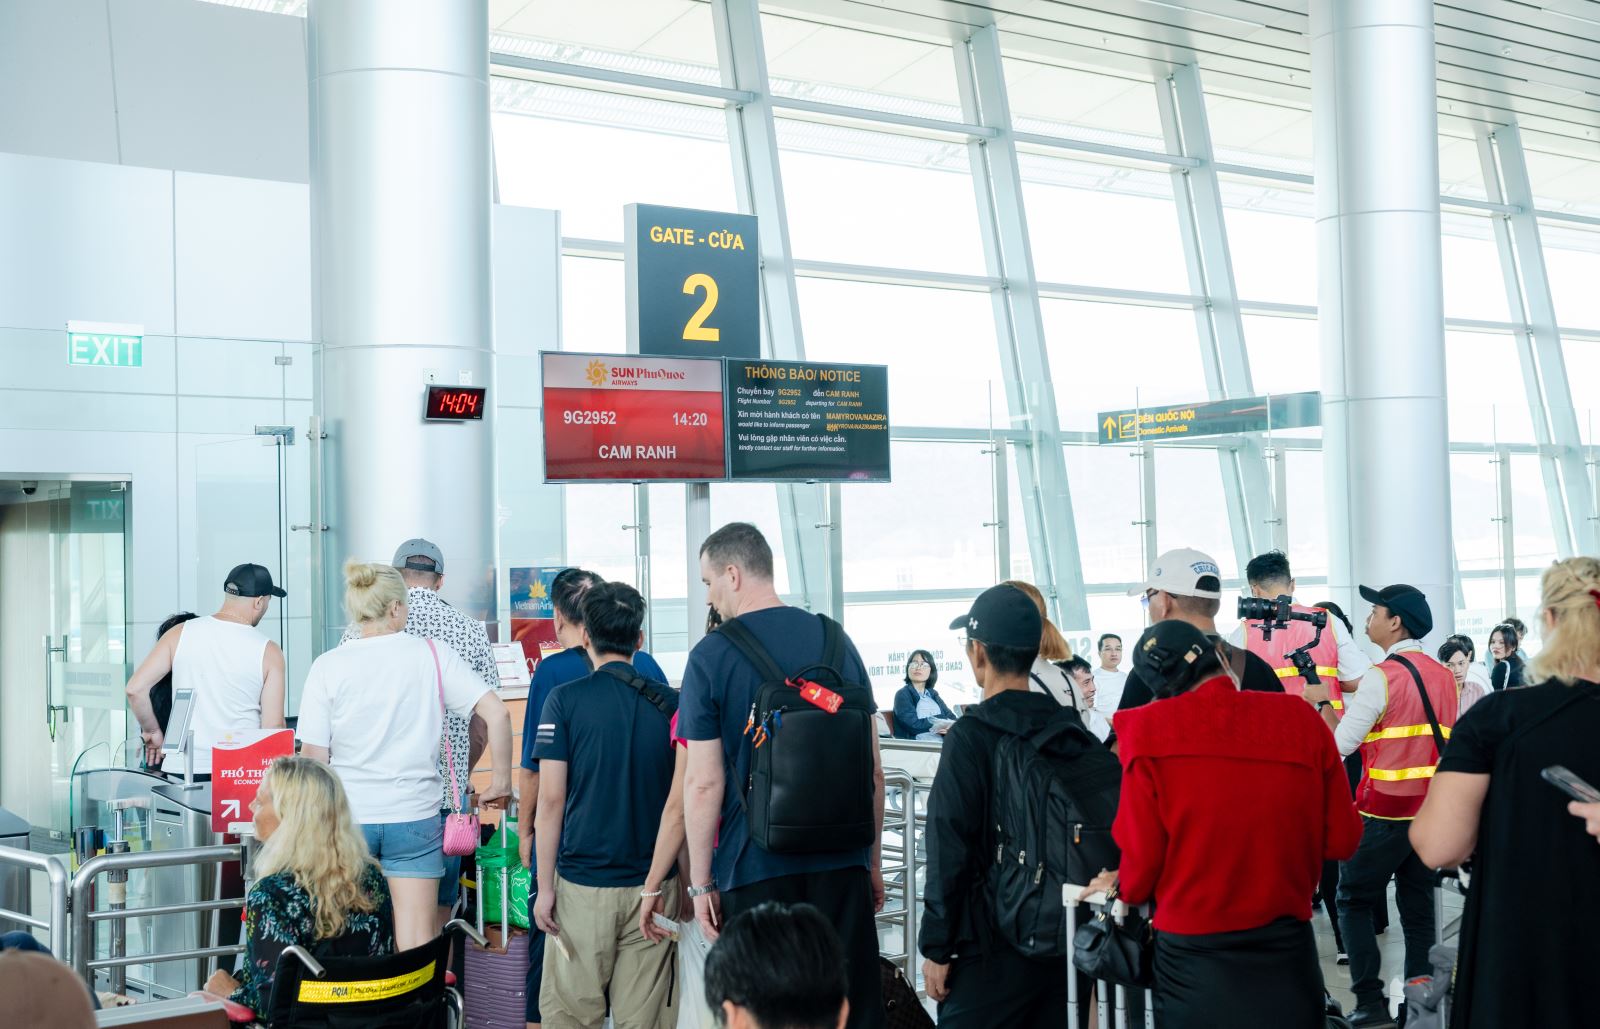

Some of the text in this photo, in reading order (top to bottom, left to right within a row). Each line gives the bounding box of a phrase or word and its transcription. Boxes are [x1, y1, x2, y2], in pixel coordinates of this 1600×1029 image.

[650, 226, 695, 246] GATE
[708, 229, 745, 251] CỬA
[683, 273, 720, 342] 2
[72, 335, 140, 366] EXIT
[611, 367, 686, 380] SUN PhuQuoc
[745, 364, 786, 380] THÔNG
[820, 370, 861, 383] NOTICE
[736, 385, 801, 397] Chuyến bay 9G2952
[825, 390, 840, 398] CAM
[841, 390, 860, 398] RANH
[440, 393, 478, 414] 14:04
[737, 397, 752, 405] Flight
[563, 410, 708, 426] 9G2952 14:20
[737, 410, 749, 418] Xin
[749, 410, 763, 418] mời
[763, 411, 780, 419] hành
[781, 411, 801, 419] khách
[810, 412, 821, 420] tên
[1155, 410, 1179, 422] QUỐC
[1180, 410, 1195, 421] NỘI
[1165, 424, 1188, 433] Arrivals
[738, 433, 749, 441] Vui
[750, 434, 765, 443] lòng
[779, 434, 795, 442] nhân
[820, 435, 833, 443] việc
[598, 445, 677, 460] CAM RANH
[331, 986, 349, 997] PQIA
